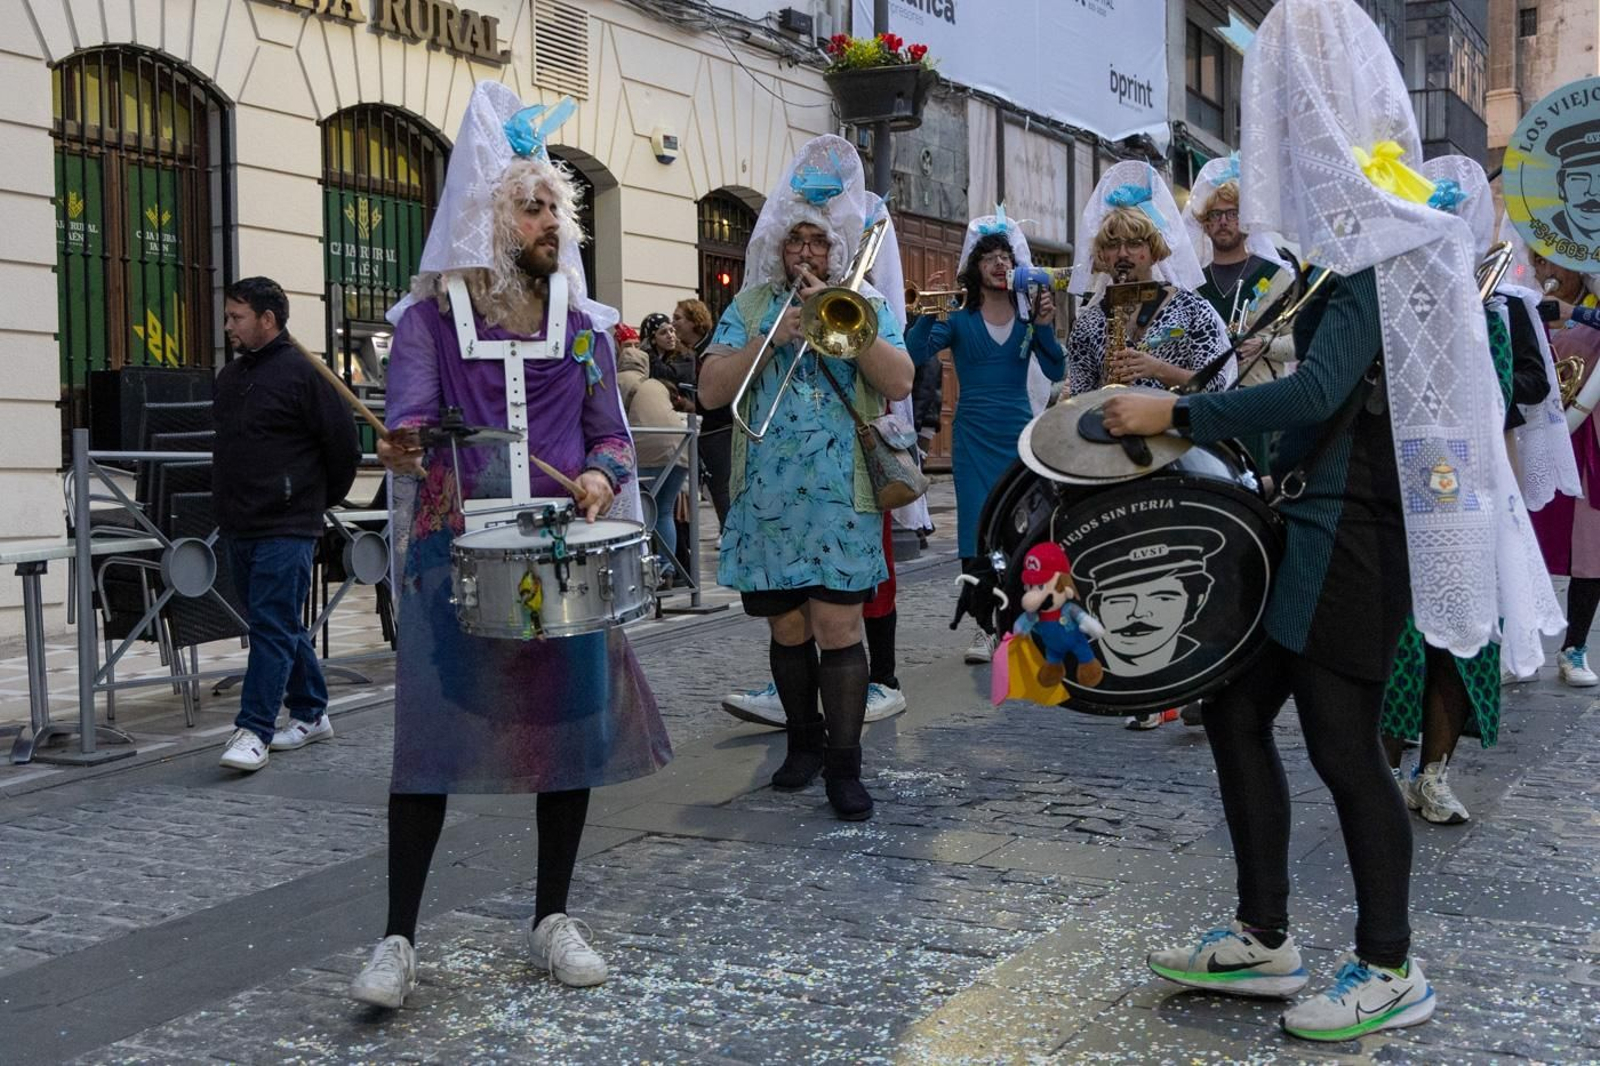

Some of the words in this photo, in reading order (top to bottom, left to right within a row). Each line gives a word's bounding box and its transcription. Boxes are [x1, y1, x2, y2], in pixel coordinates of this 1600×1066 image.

[368, 0, 511, 67] RURAL
[1519, 116, 1548, 153] LOS
[1101, 506, 1127, 523] SIN
[1131, 499, 1174, 513] FERIA
